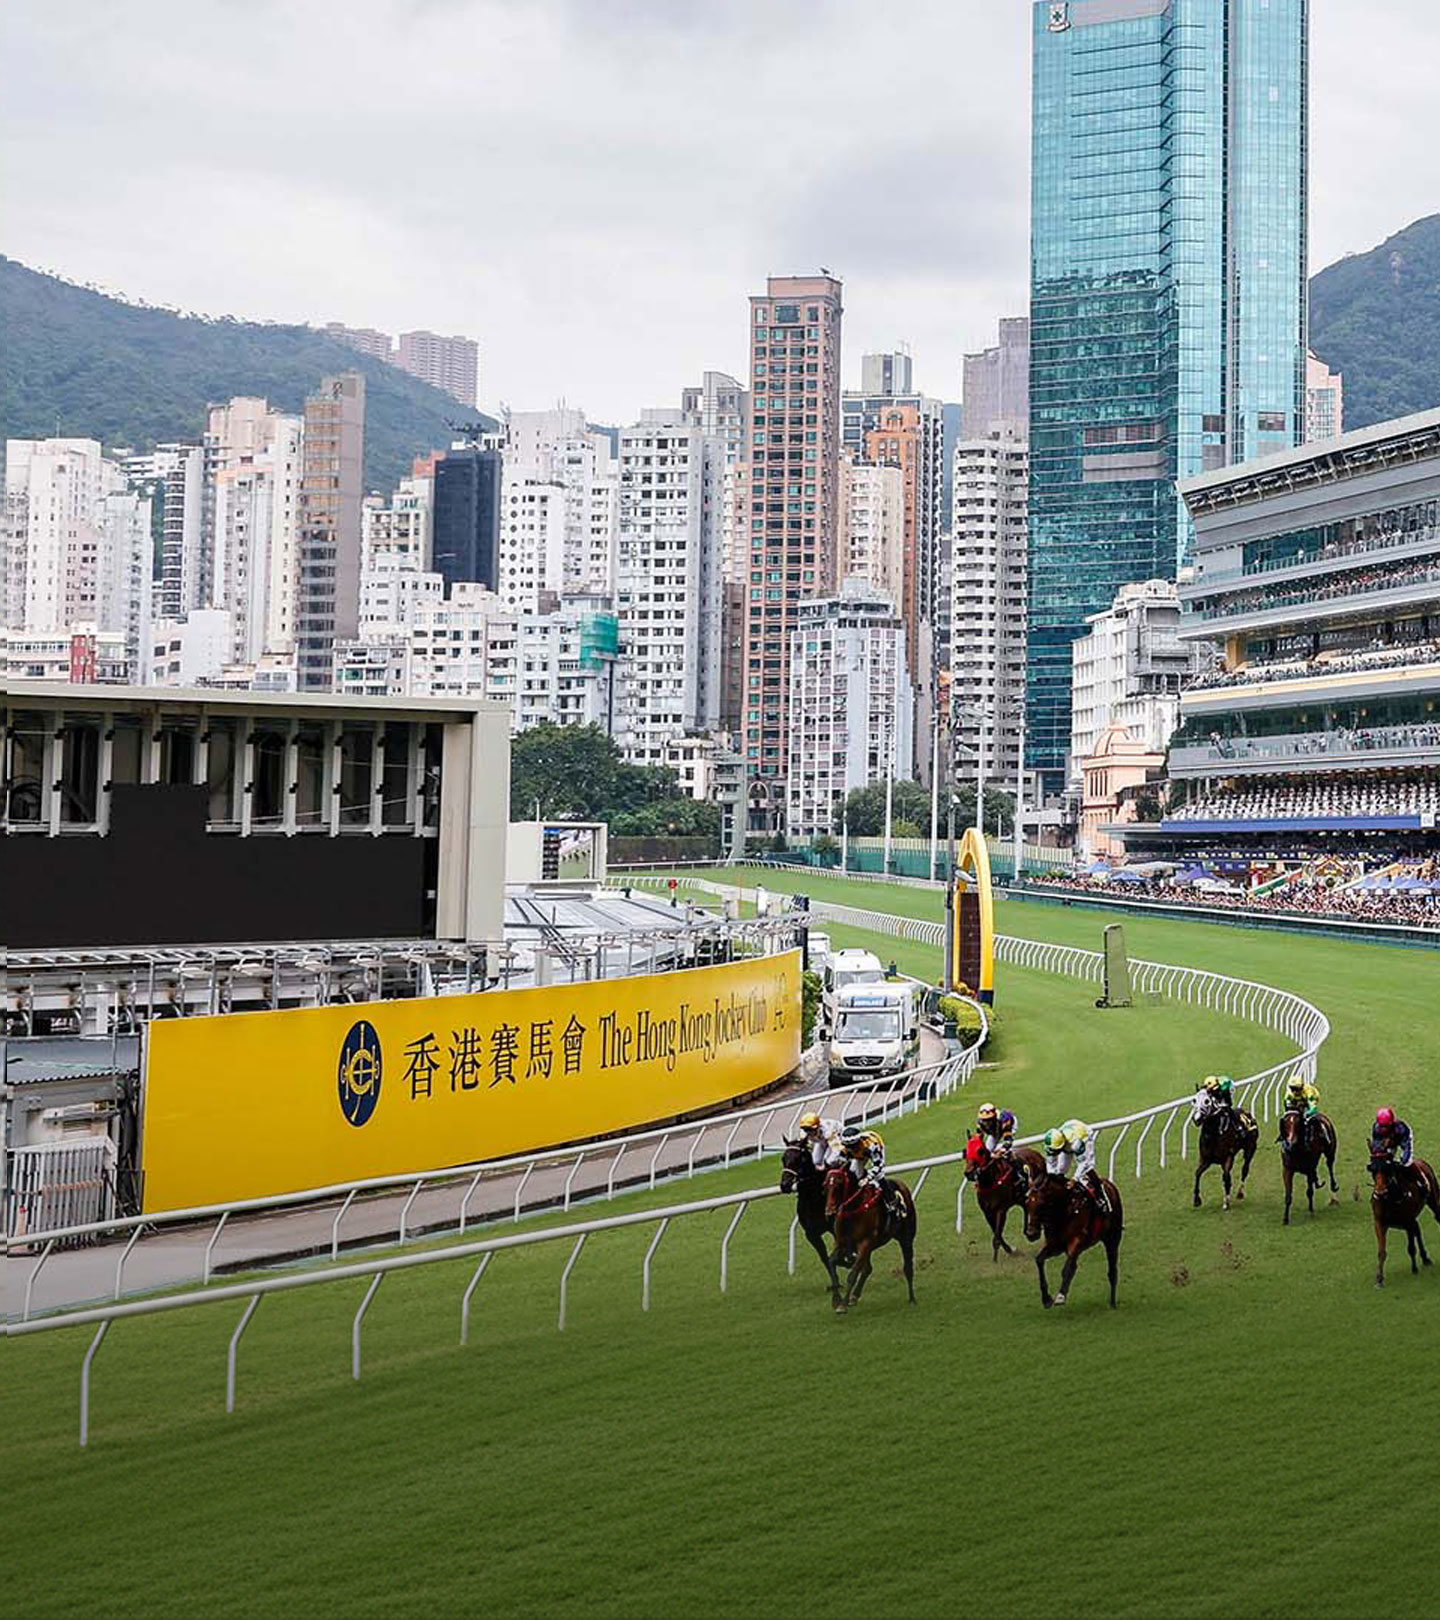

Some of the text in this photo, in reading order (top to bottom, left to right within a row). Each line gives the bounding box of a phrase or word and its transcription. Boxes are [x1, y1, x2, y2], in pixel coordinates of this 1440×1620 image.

[402, 1014, 587, 1101] 香港賽馬會
[600, 1010, 632, 1070] The
[636, 1010, 677, 1072] Hong
[679, 1003, 711, 1064] Kong
[711, 991, 750, 1060] Jockey
